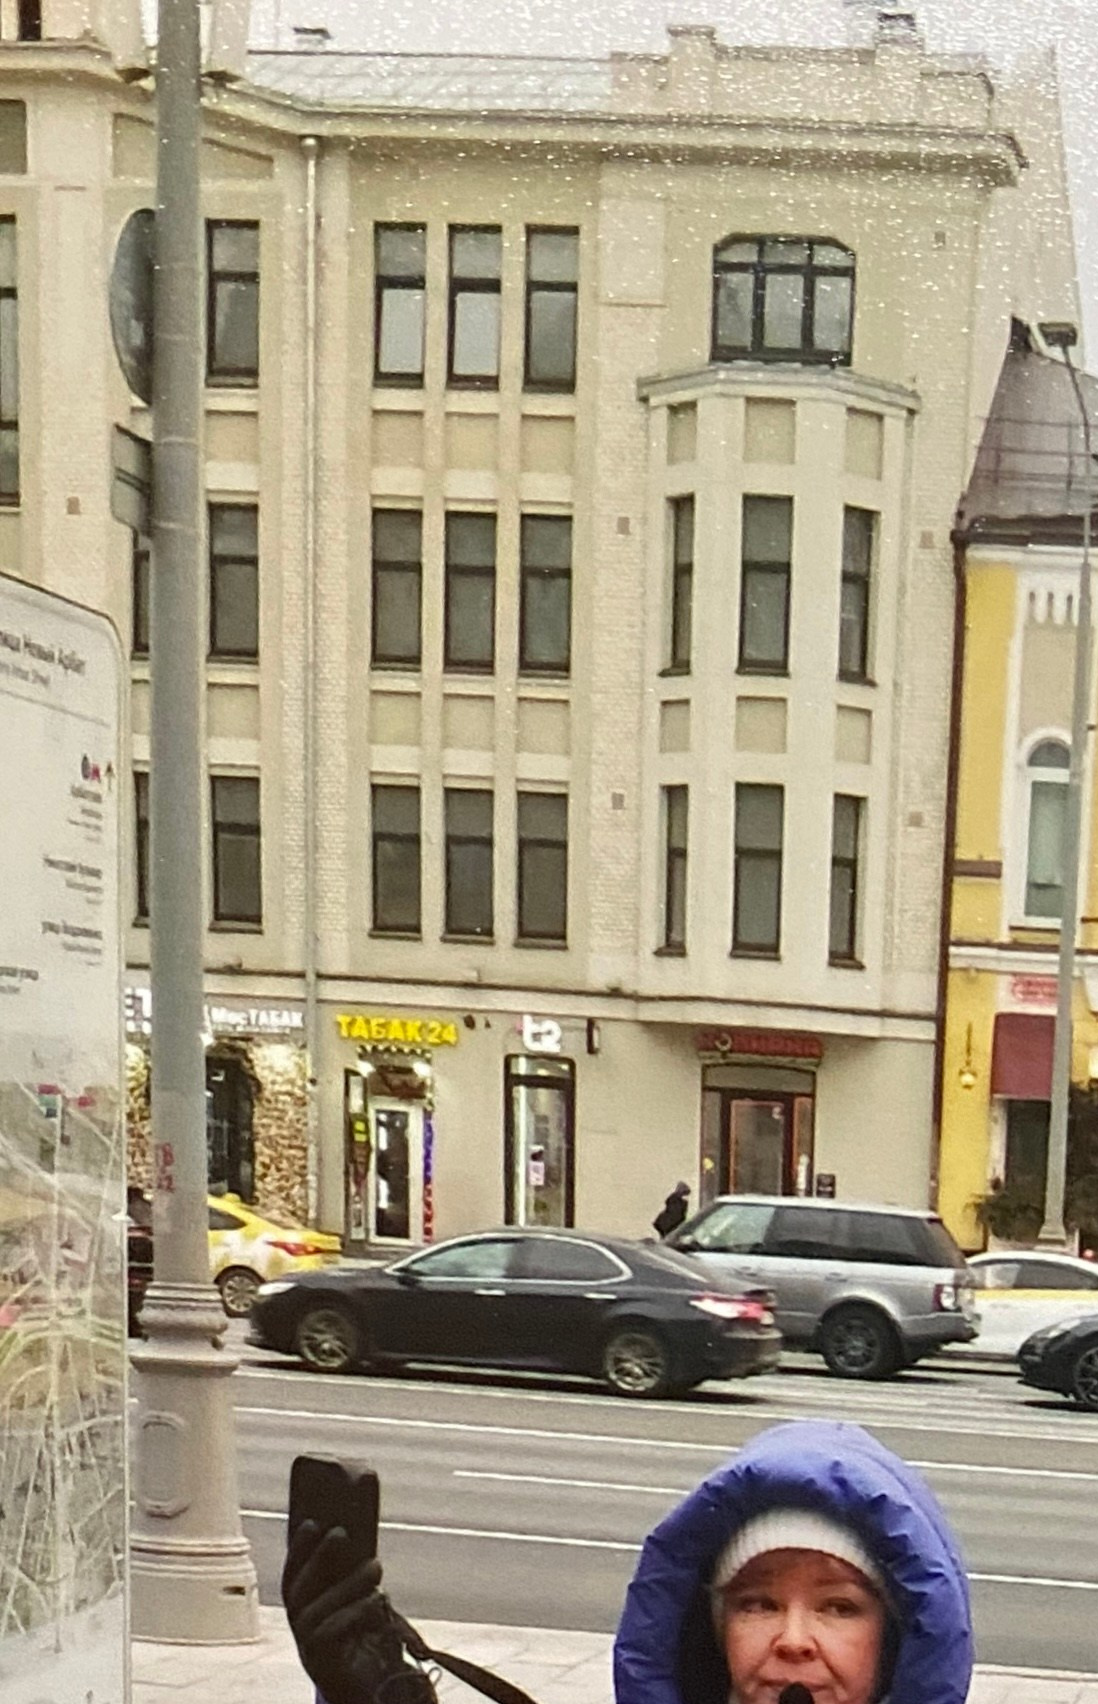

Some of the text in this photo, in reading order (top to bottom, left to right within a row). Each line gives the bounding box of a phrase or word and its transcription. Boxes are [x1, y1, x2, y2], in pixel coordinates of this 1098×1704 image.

[335, 1013, 459, 1046] ТАБАК 24
[522, 1013, 563, 1053] t2
